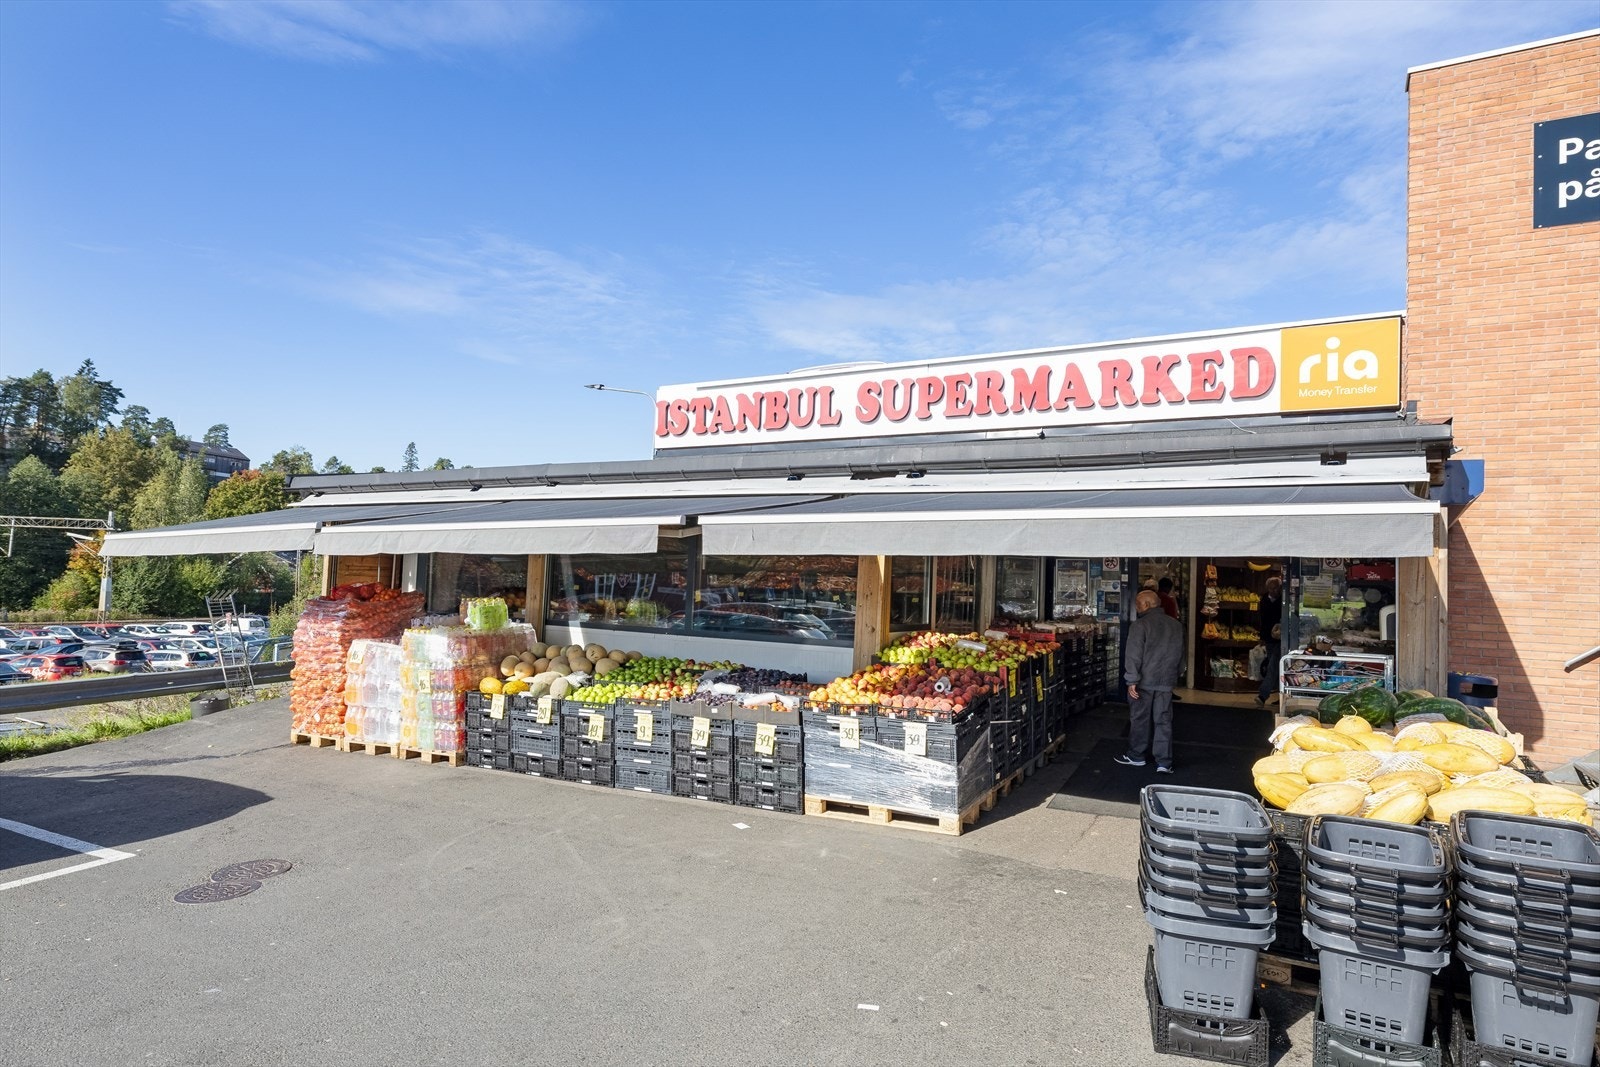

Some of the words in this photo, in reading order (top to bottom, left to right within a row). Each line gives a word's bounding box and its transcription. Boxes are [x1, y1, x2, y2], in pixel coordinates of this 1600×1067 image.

[1558, 168, 1600, 208] på
[1299, 336, 1379, 384] ria
[656, 386, 842, 436] ISTANBUL
[855, 347, 1277, 423] SUPERMARKED
[1299, 388, 1333, 398] Money
[1335, 384, 1378, 395] Transfer
